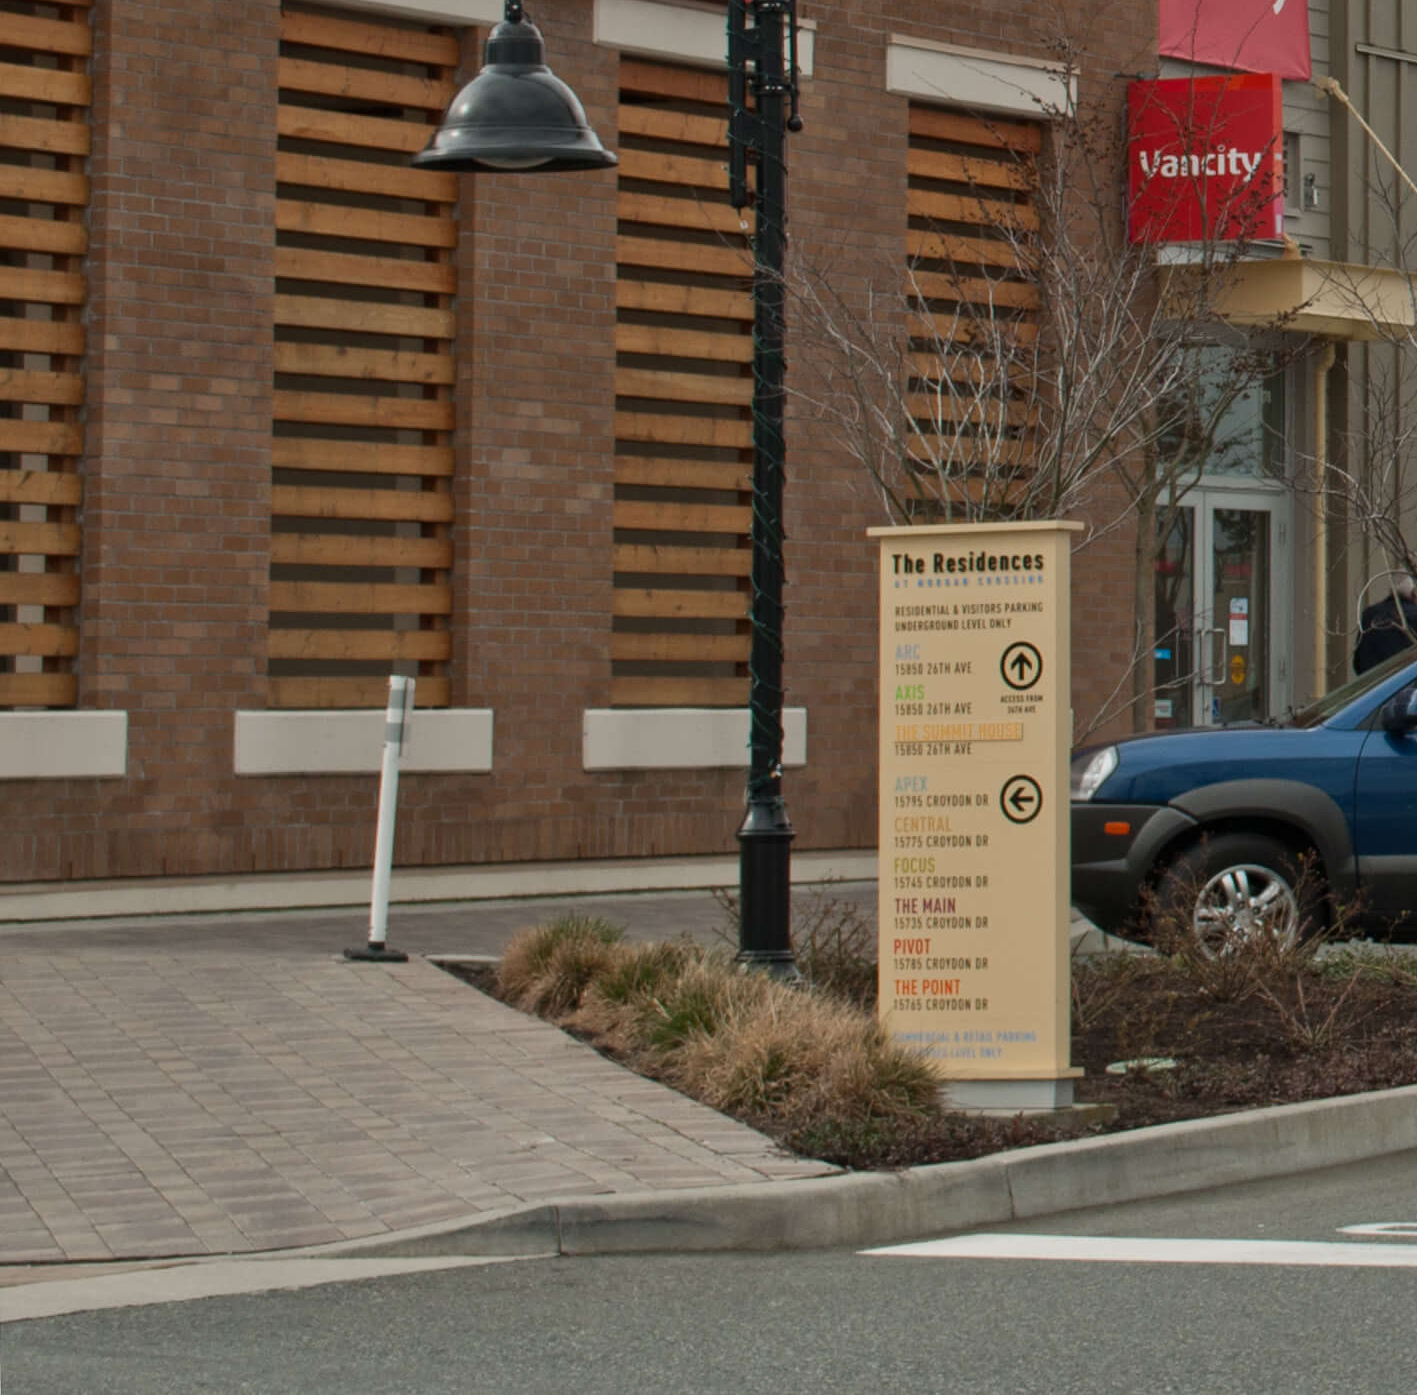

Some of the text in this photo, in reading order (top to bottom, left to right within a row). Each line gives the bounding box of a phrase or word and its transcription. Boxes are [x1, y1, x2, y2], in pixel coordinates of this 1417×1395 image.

[1139, 144, 1261, 182] Vancity
[892, 551, 1044, 574] The Residences
[895, 602, 1043, 617] RESIDENTIAL & VISITORS PARKING
[895, 618, 1012, 632] UNDERGROUND LEVEL ONLY
[895, 644, 921, 661] ARC
[895, 662, 972, 676] 15850 26TH AVE
[895, 684, 925, 701] AXIS
[895, 702, 972, 716] 15850 26TH AVE
[895, 723, 1020, 741] THE SUMMIT HOUSE
[926, 742, 950, 755] 26TH
[953, 742, 972, 754] AVE
[895, 776, 928, 792] APEX
[926, 794, 971, 807] CROYDON
[976, 794, 989, 806] DR
[895, 816, 953, 833] CENTRAL
[926, 835, 971, 848] CROYDON
[976, 835, 989, 847] DR
[894, 857, 936, 873] FOCUS
[926, 876, 971, 889] CROYDON
[976, 876, 989, 888] DR
[895, 897, 956, 914] THE MAIN
[926, 916, 971, 929] CROYDON
[976, 916, 989, 928] DR
[893, 938, 931, 955] PIVOT
[926, 957, 971, 970] CROYDON
[976, 957, 989, 969] DR
[895, 979, 960, 996] THE POINT
[926, 998, 971, 1011] CROYDON
[976, 998, 989, 1010] DR
